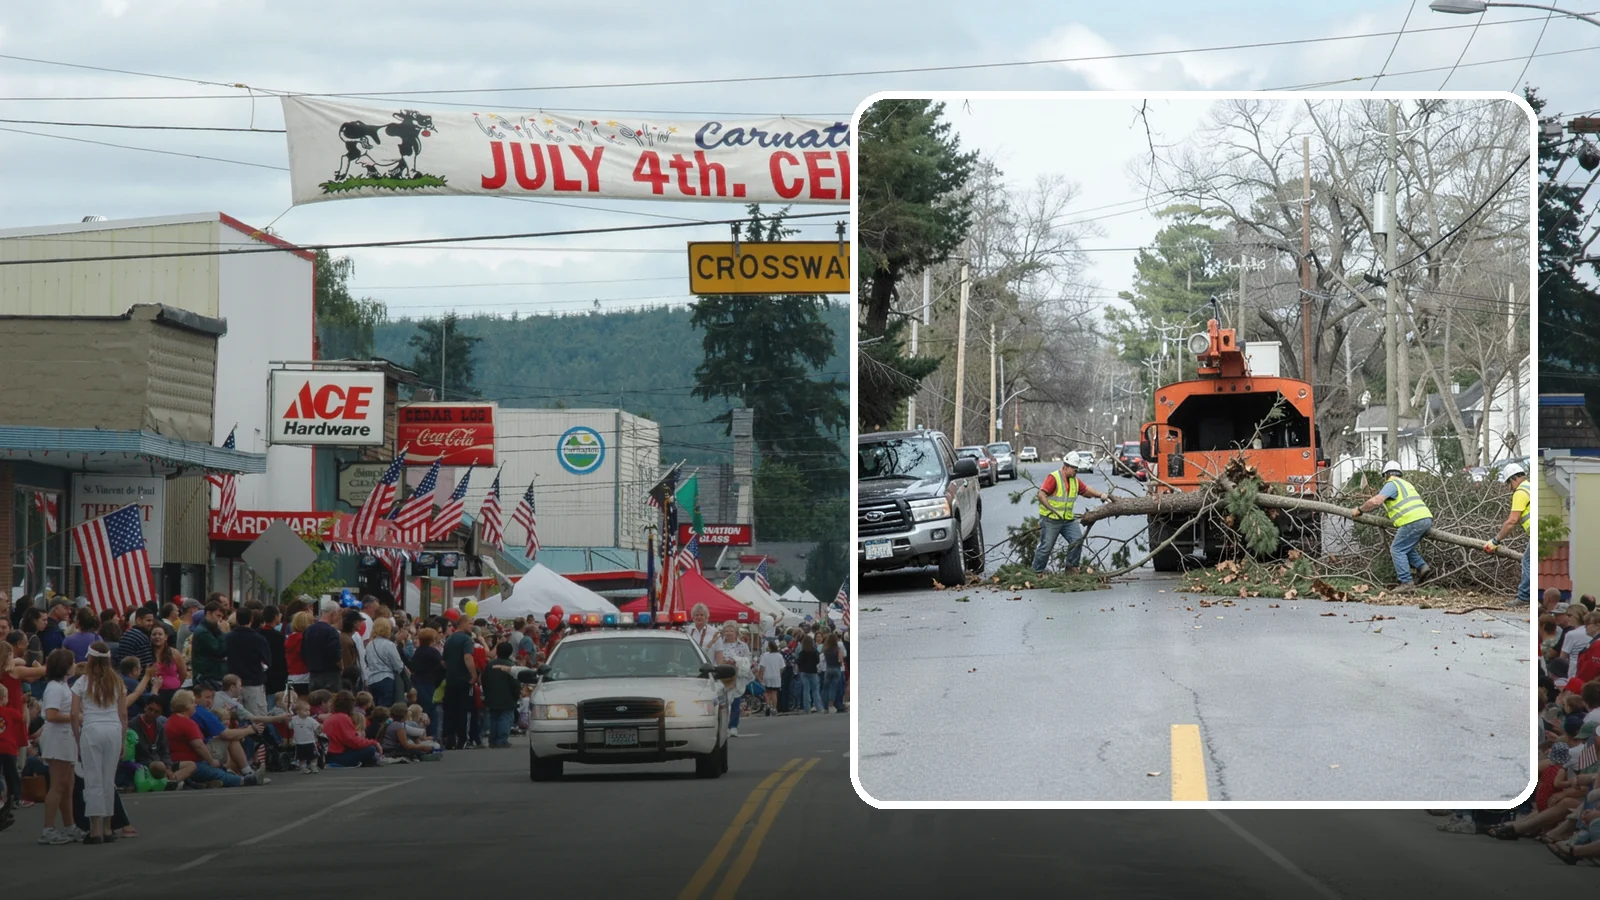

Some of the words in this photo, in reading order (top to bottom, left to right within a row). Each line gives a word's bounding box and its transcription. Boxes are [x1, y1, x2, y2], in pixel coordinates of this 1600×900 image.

[695, 121, 850, 149] Carnat
[481, 140, 605, 192] JULY
[632, 150, 746, 197] 4th.
[697, 254, 850, 280] CROSSWA
[282, 380, 374, 420] ACE
[406, 409, 452, 421] CEDAR
[461, 409, 485, 421] LOG
[284, 421, 371, 436] Hardware
[353, 467, 386, 480] Simpl
[83, 485, 93, 494] St.
[95, 485, 124, 495] Vincent
[126, 486, 135, 495] de
[137, 486, 155, 495] Paul
[688, 527, 741, 535] CRNATION
[699, 535, 730, 543] GLASS
